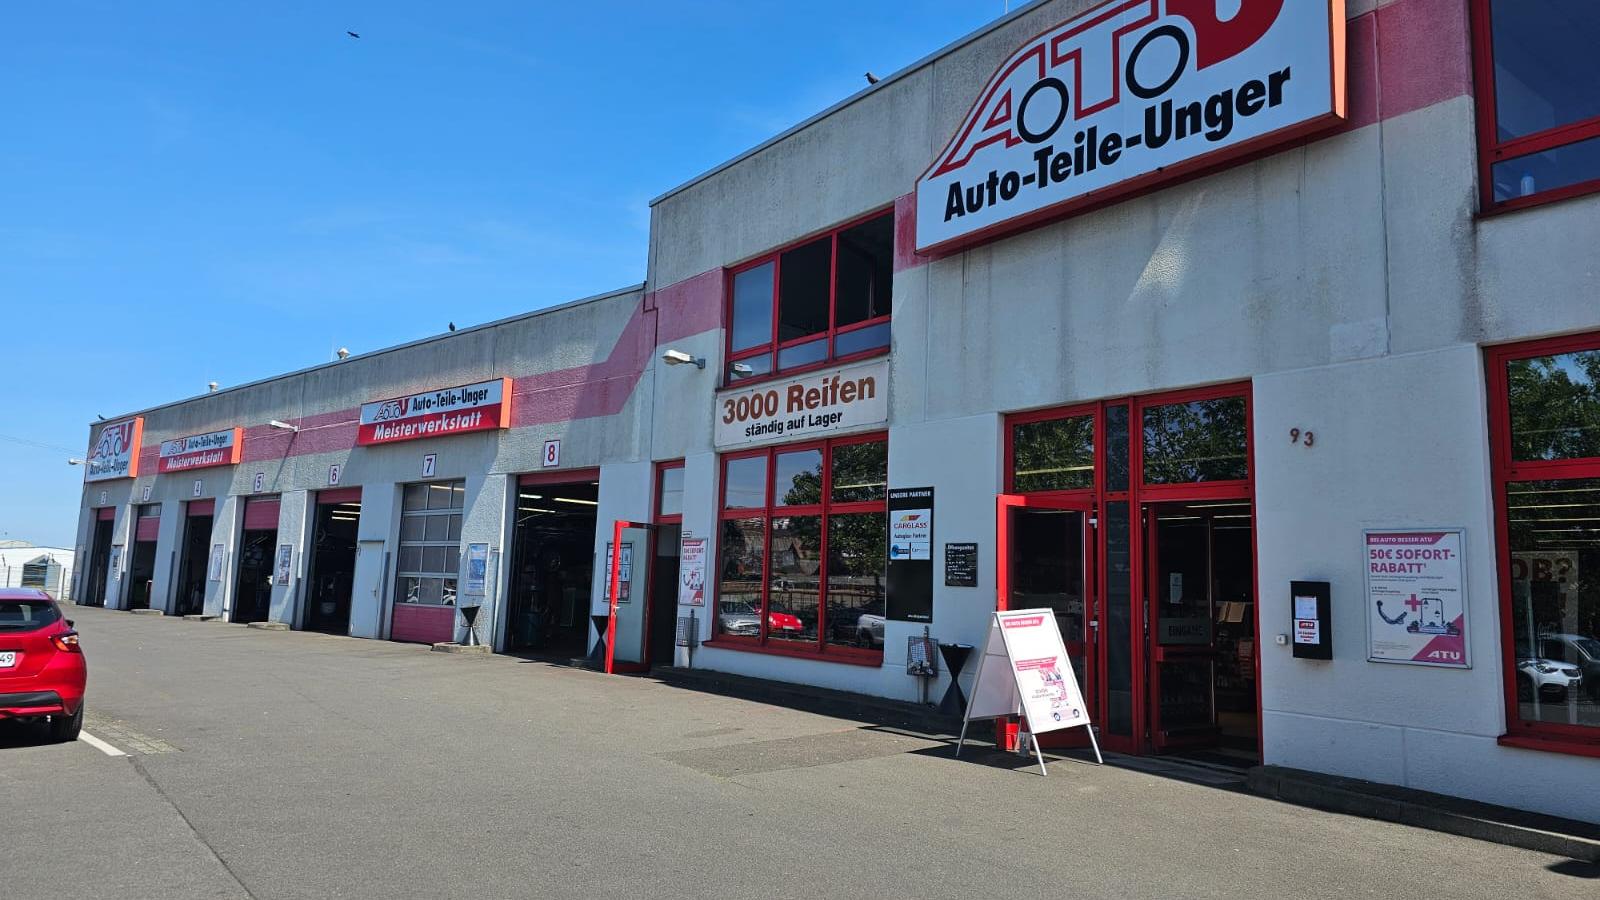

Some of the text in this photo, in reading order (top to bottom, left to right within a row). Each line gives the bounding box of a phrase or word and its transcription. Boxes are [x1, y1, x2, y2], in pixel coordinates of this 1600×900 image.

[943, 66, 1291, 223] Auto-Teile-Unger
[412, 388, 488, 412] Auto-Teile-Unger
[722, 375, 875, 425] 3000 Reifen
[373, 411, 482, 441] Meisterwerkstatt
[745, 411, 843, 437] ständig auf Lager
[167, 451, 223, 469] Meisterwerkstatt
[547, 445, 556, 462] 8
[425, 458, 434, 473] 7
[255, 475, 263, 488] 5
[331, 468, 338, 481] 6
[1370, 548, 1456, 560] 50€ SOFORT-
[1427, 650, 1461, 660] ATU
